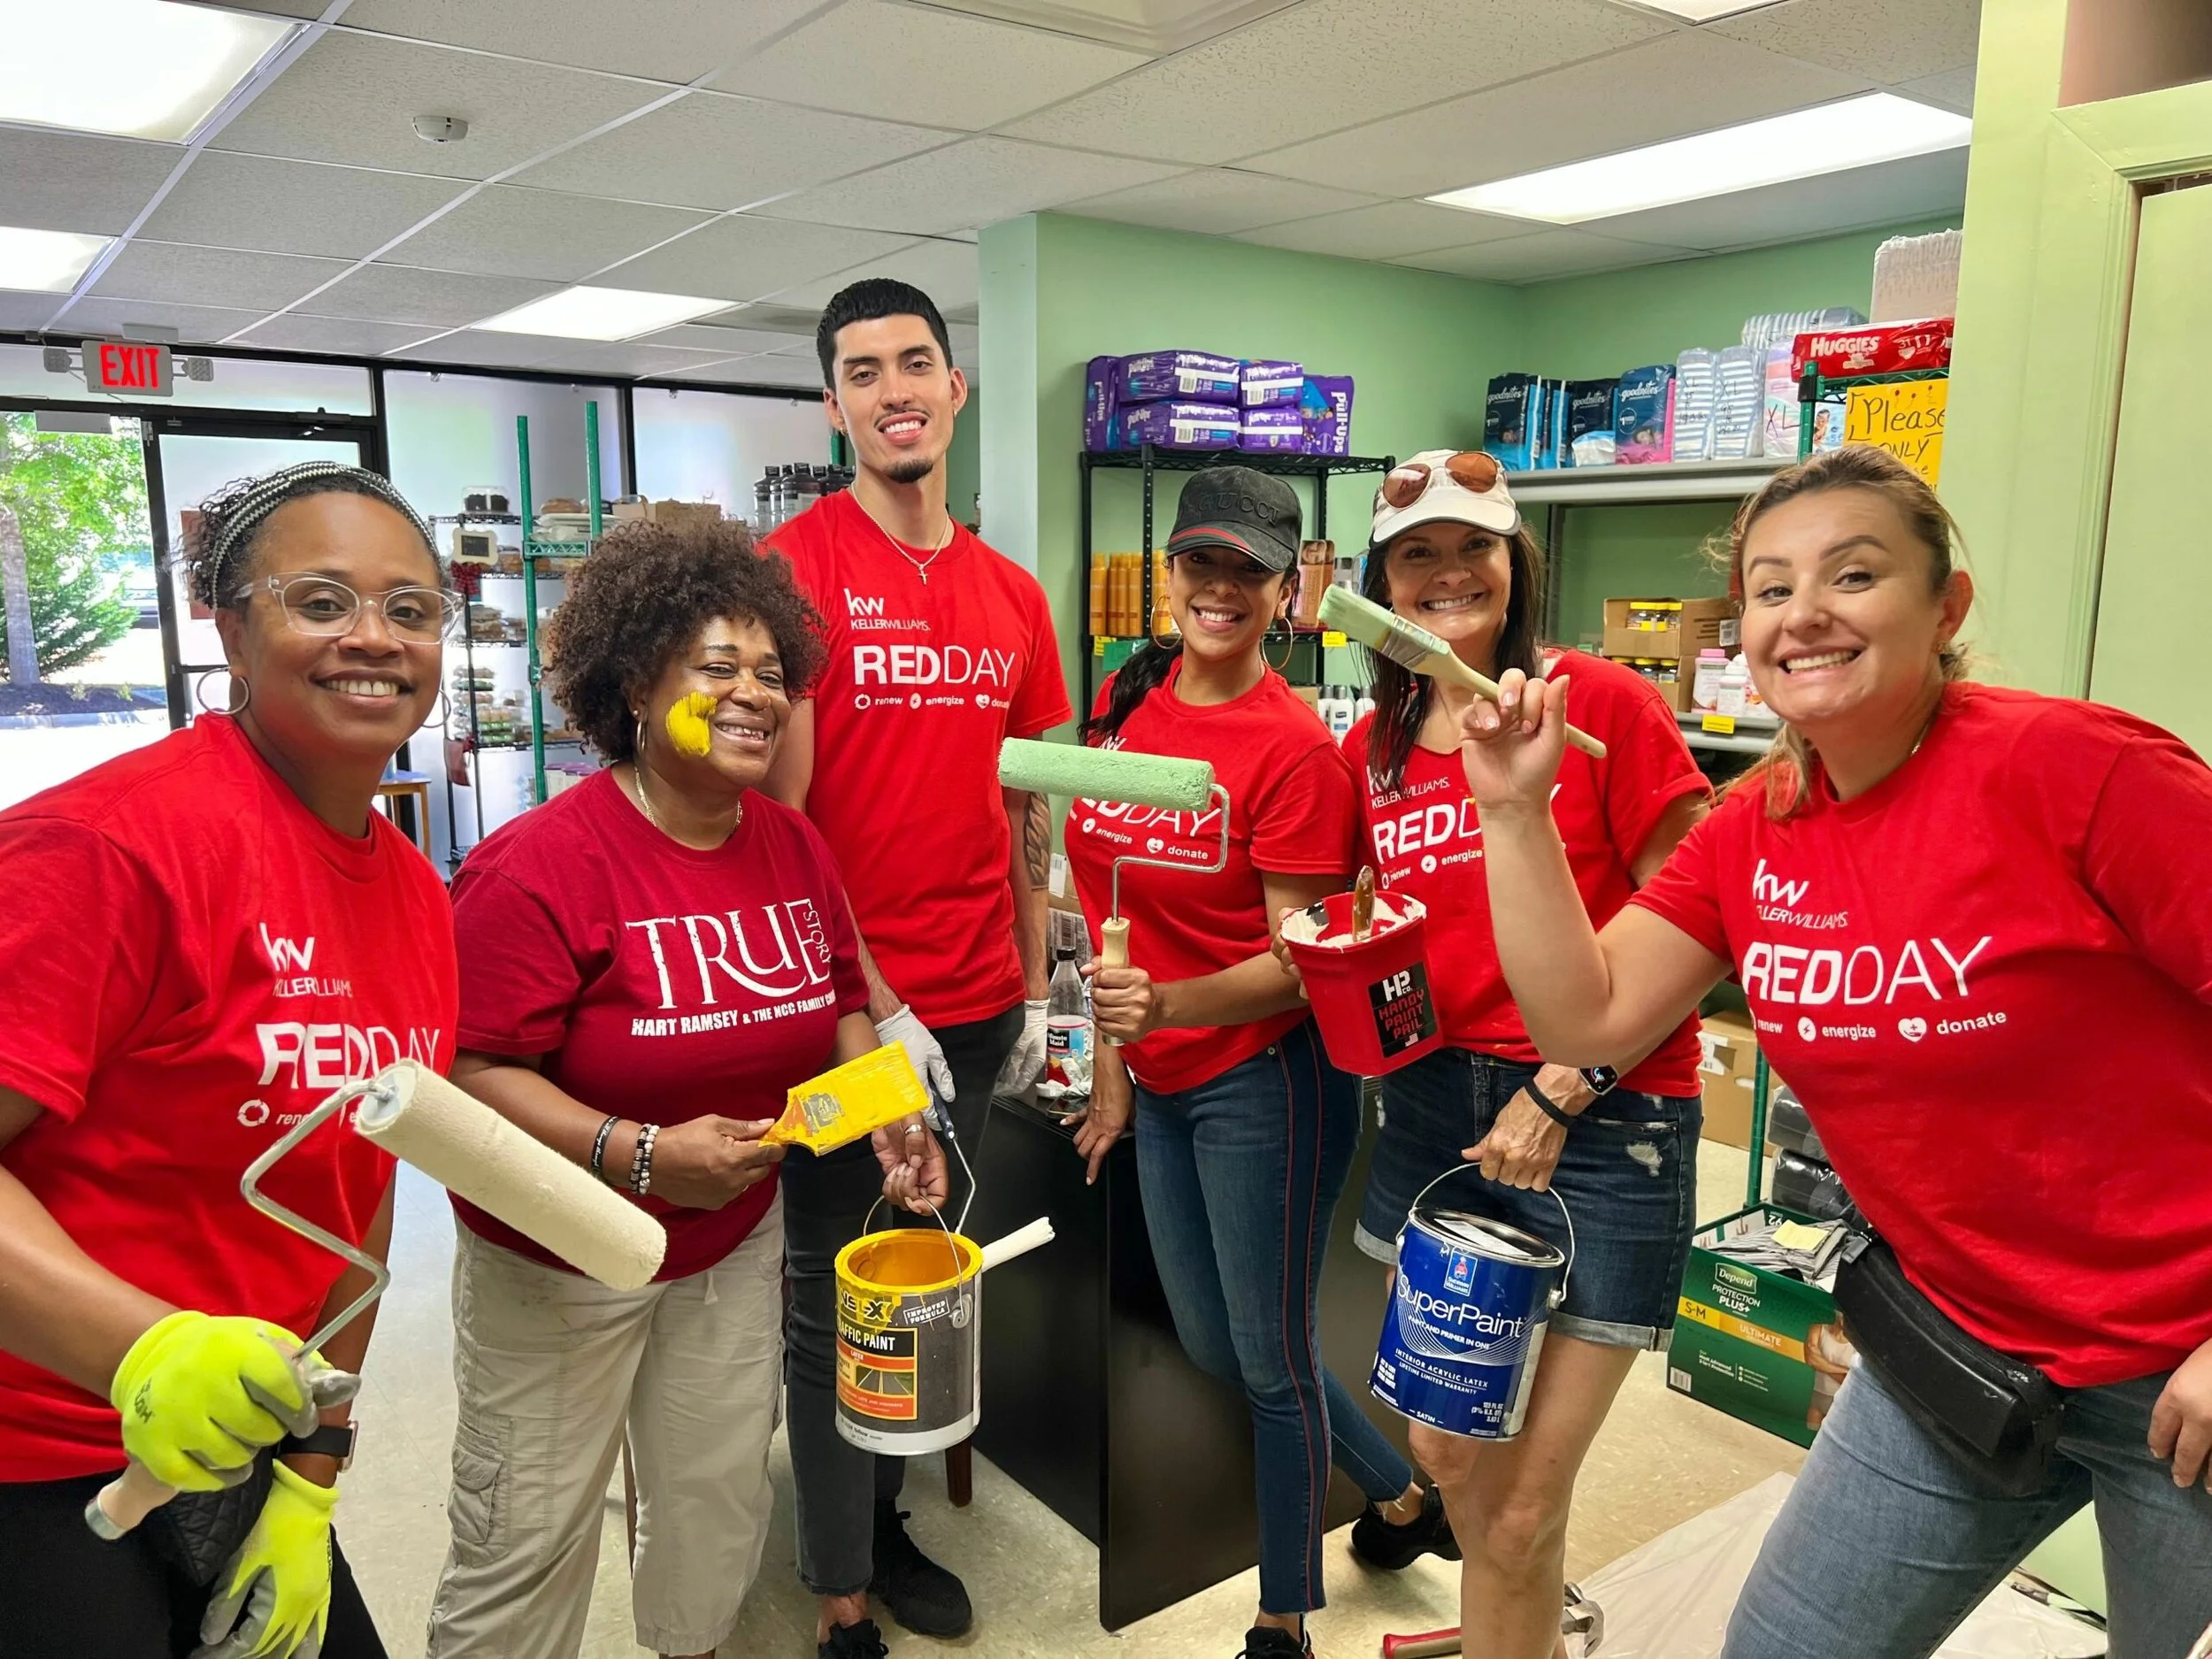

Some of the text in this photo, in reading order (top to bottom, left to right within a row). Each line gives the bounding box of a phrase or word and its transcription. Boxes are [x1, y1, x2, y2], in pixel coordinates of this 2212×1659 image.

[1810, 335, 1880, 357] HUGGIES
[100, 344, 159, 388] EXIT
[1487, 385, 1522, 404] goodnites
[1571, 389, 1606, 411] goodnites
[1620, 380, 1660, 403] goodnites
[1765, 404, 1801, 439] XL
[1863, 397, 1947, 434] Please
[1199, 492, 1280, 526] GUCCI
[844, 588, 885, 617] kw
[875, 695, 903, 706] renew
[926, 695, 965, 707] energize
[1096, 828, 1209, 860] energize donate
[1440, 848, 1483, 866] energize
[803, 910, 831, 964] STORY
[625, 898, 831, 1009] TRUE
[1382, 970, 1411, 1002] HP
[631, 1018, 678, 1036] HART
[680, 1010, 738, 1034] RAMSEY
[742, 1013, 752, 1024] &
[752, 1007, 772, 1022] THE
[773, 1002, 795, 1018] NCC
[796, 995, 826, 1013] FAMILY
[1379, 988, 1425, 1020] HANDY
[1385, 1004, 1424, 1031] PAINT
[1394, 1021, 1424, 1040] PAIL
[1757, 1010, 2008, 1041] renew energize donate
[1718, 1267, 1755, 1287] Depend
[907, 1300, 946, 1317] IMPROVED
[1398, 1274, 1524, 1338] SuperPaint
[1712, 1284, 1761, 1308] PROTECTION
[1718, 1295, 1751, 1313] PLUS+
[910, 1308, 946, 1324] FORMULA
[1685, 1301, 1707, 1320] S-M
[864, 1333, 896, 1351] PAINT
[1409, 1315, 1490, 1349] PAINT AND PRIMER IN ONE
[1740, 1323, 1782, 1347] ULTIMATE
[1395, 1348, 1488, 1387] INTERIOR ACRYLIC LATEX
[1399, 1362, 1419, 1376] LIFETIME
[1420, 1372, 1443, 1386] LIMITED
[1444, 1381, 1477, 1395] WARRANTY
[1417, 1410, 1436, 1424] SATIN
